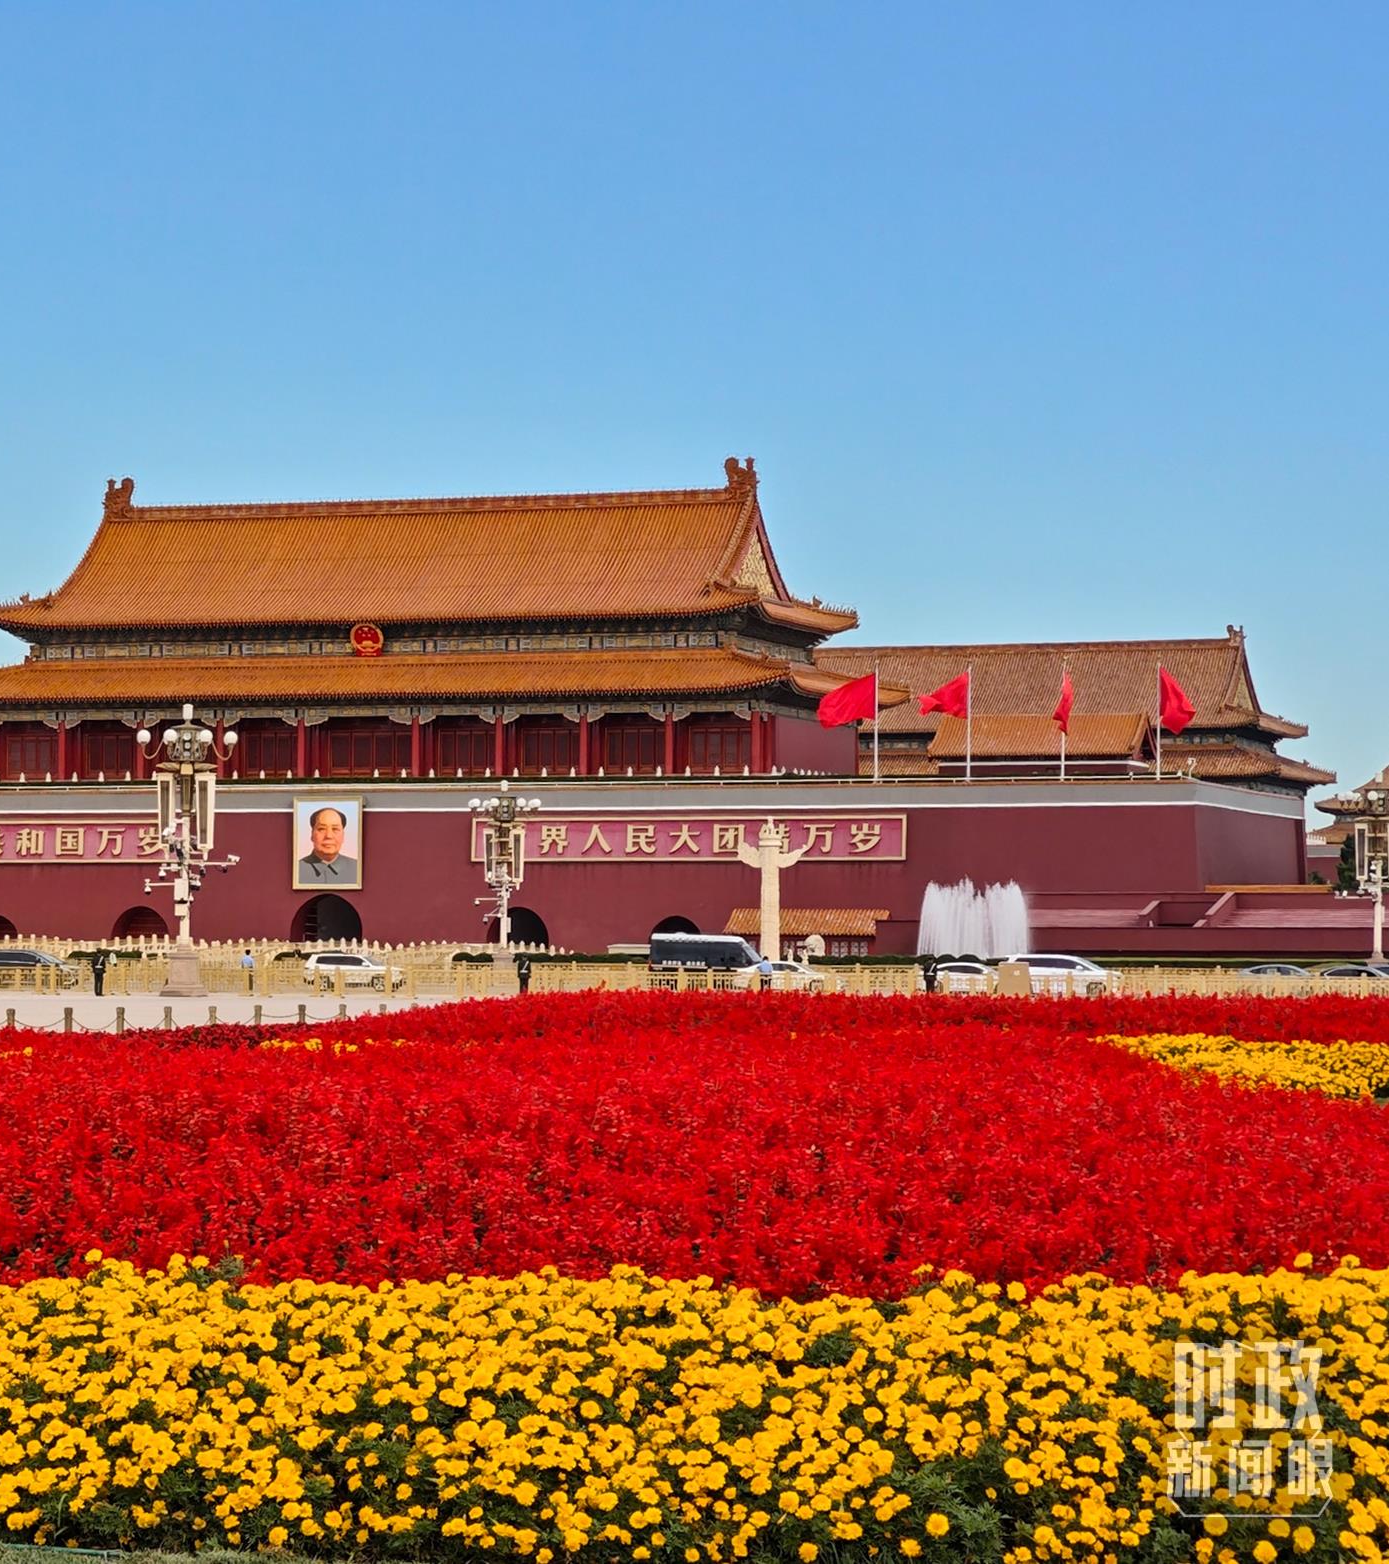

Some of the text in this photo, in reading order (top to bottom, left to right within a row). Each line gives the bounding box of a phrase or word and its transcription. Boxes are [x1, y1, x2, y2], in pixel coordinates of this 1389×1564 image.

[497, 824, 883, 853] 界人民大团万岁
